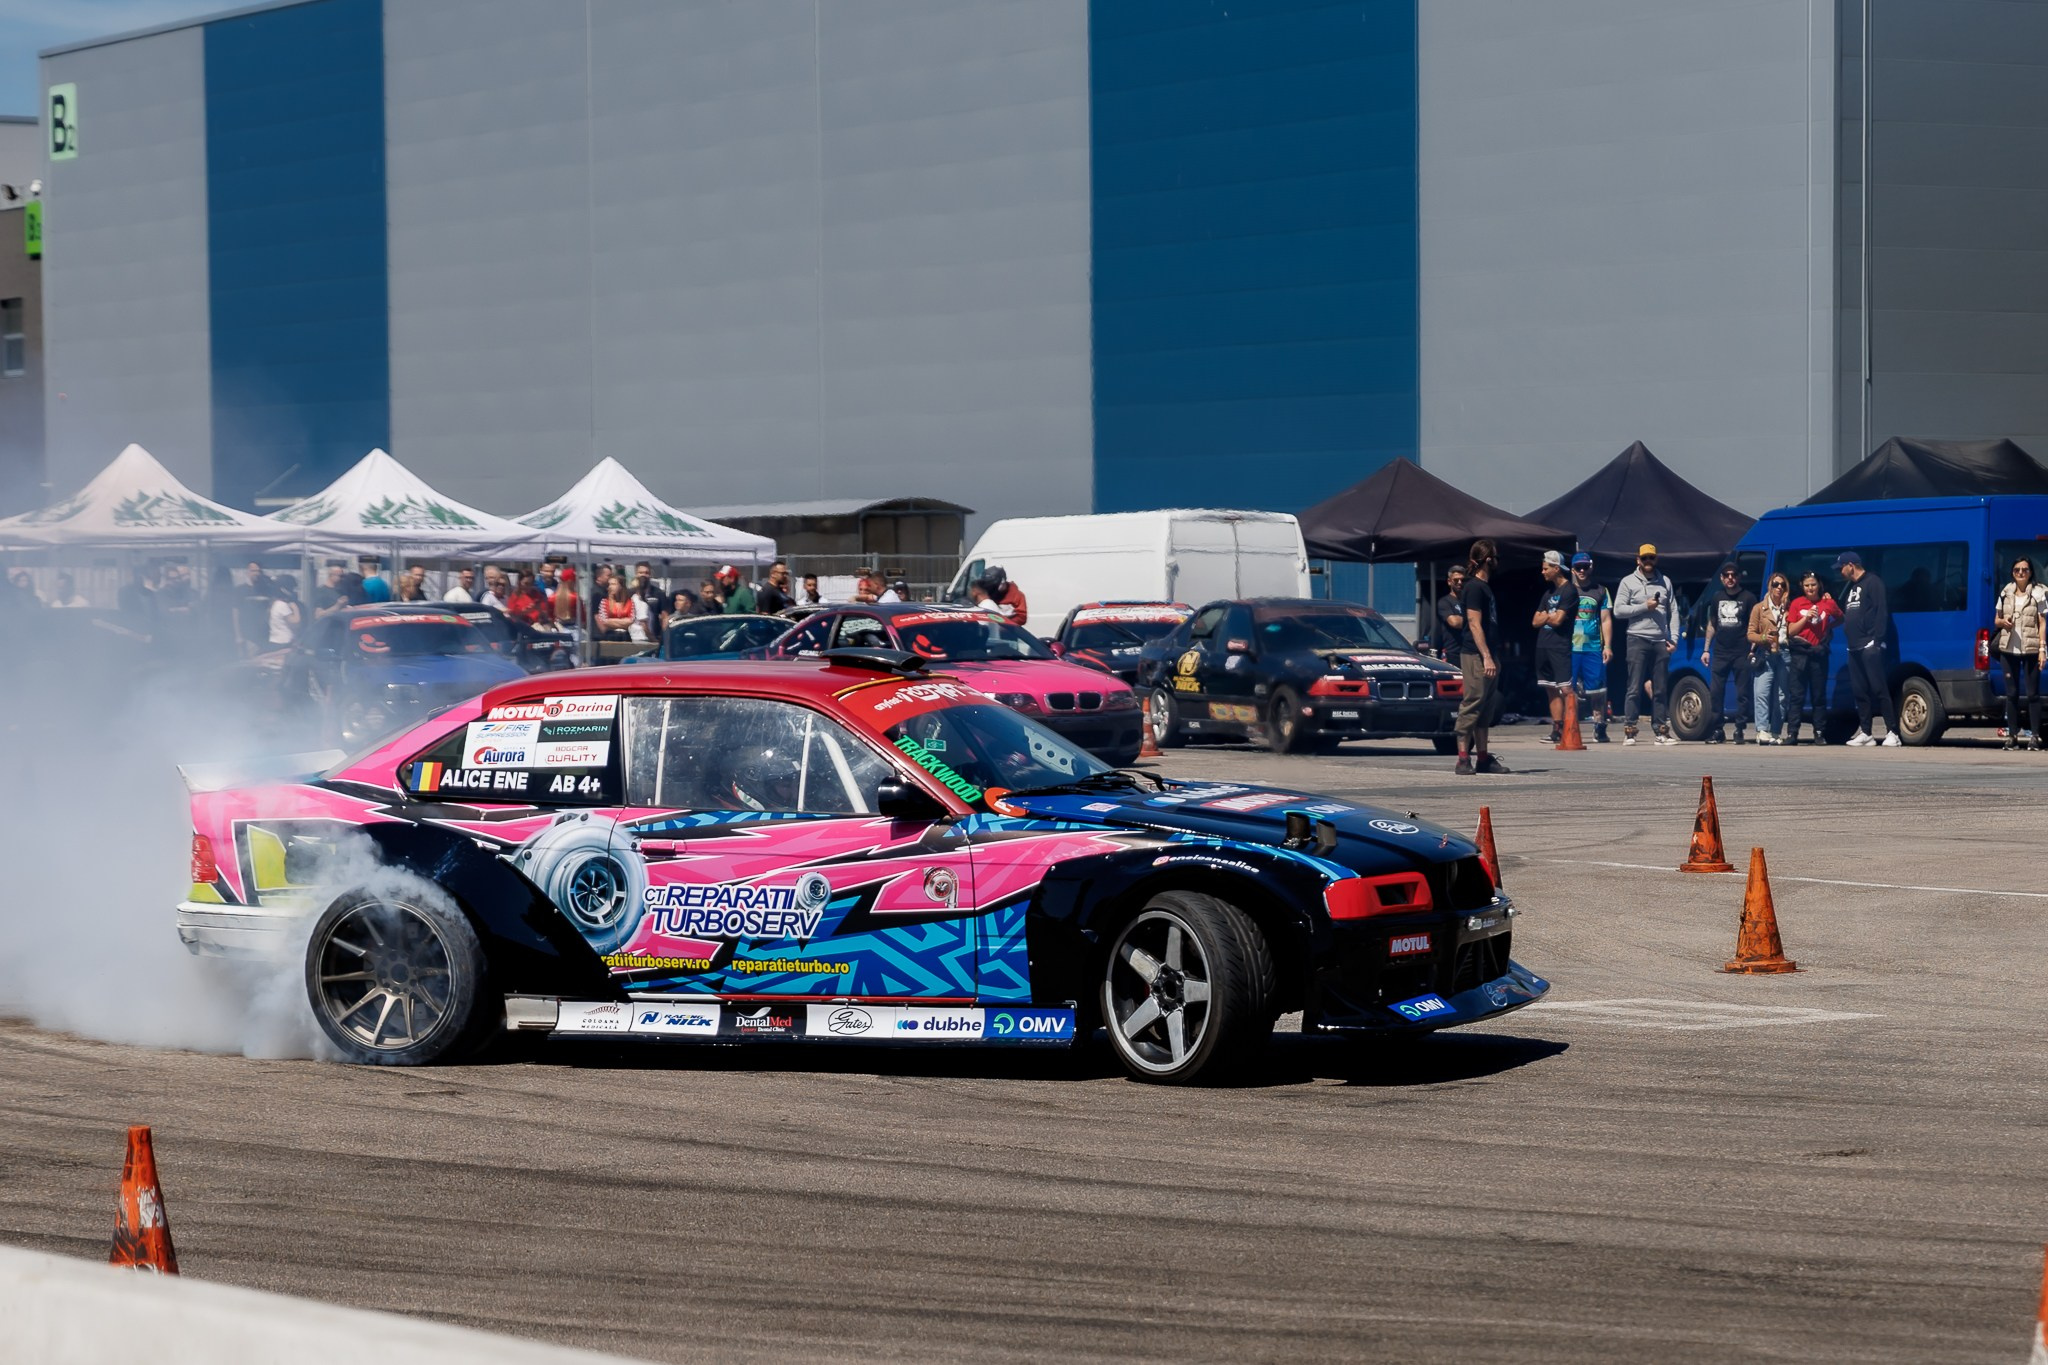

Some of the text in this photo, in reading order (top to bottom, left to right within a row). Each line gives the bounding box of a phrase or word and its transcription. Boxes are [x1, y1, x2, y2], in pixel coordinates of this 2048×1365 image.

[488, 706, 546, 720] MOTUL
[565, 702, 613, 713] Darina
[505, 723, 533, 731] FIRE
[556, 725, 608, 733] ROZMARIN
[483, 750, 525, 763] Aurora
[547, 754, 597, 763] QUALITY
[892, 735, 982, 803] TRACKWOOD
[440, 769, 529, 790] ALICE ENE
[550, 775, 601, 793] AB 4+
[645, 885, 796, 909] CT REPARATII
[652, 908, 820, 936] TURBOSERV
[1391, 936, 1430, 953] MOTUL
[732, 958, 850, 974] reparatieturbo.ro
[1414, 998, 1446, 1013] OMV
[666, 1018, 714, 1027] NICK
[735, 1016, 792, 1027] DentalMed
[924, 1016, 982, 1031] dubhe
[1018, 1016, 1067, 1033] OMV
